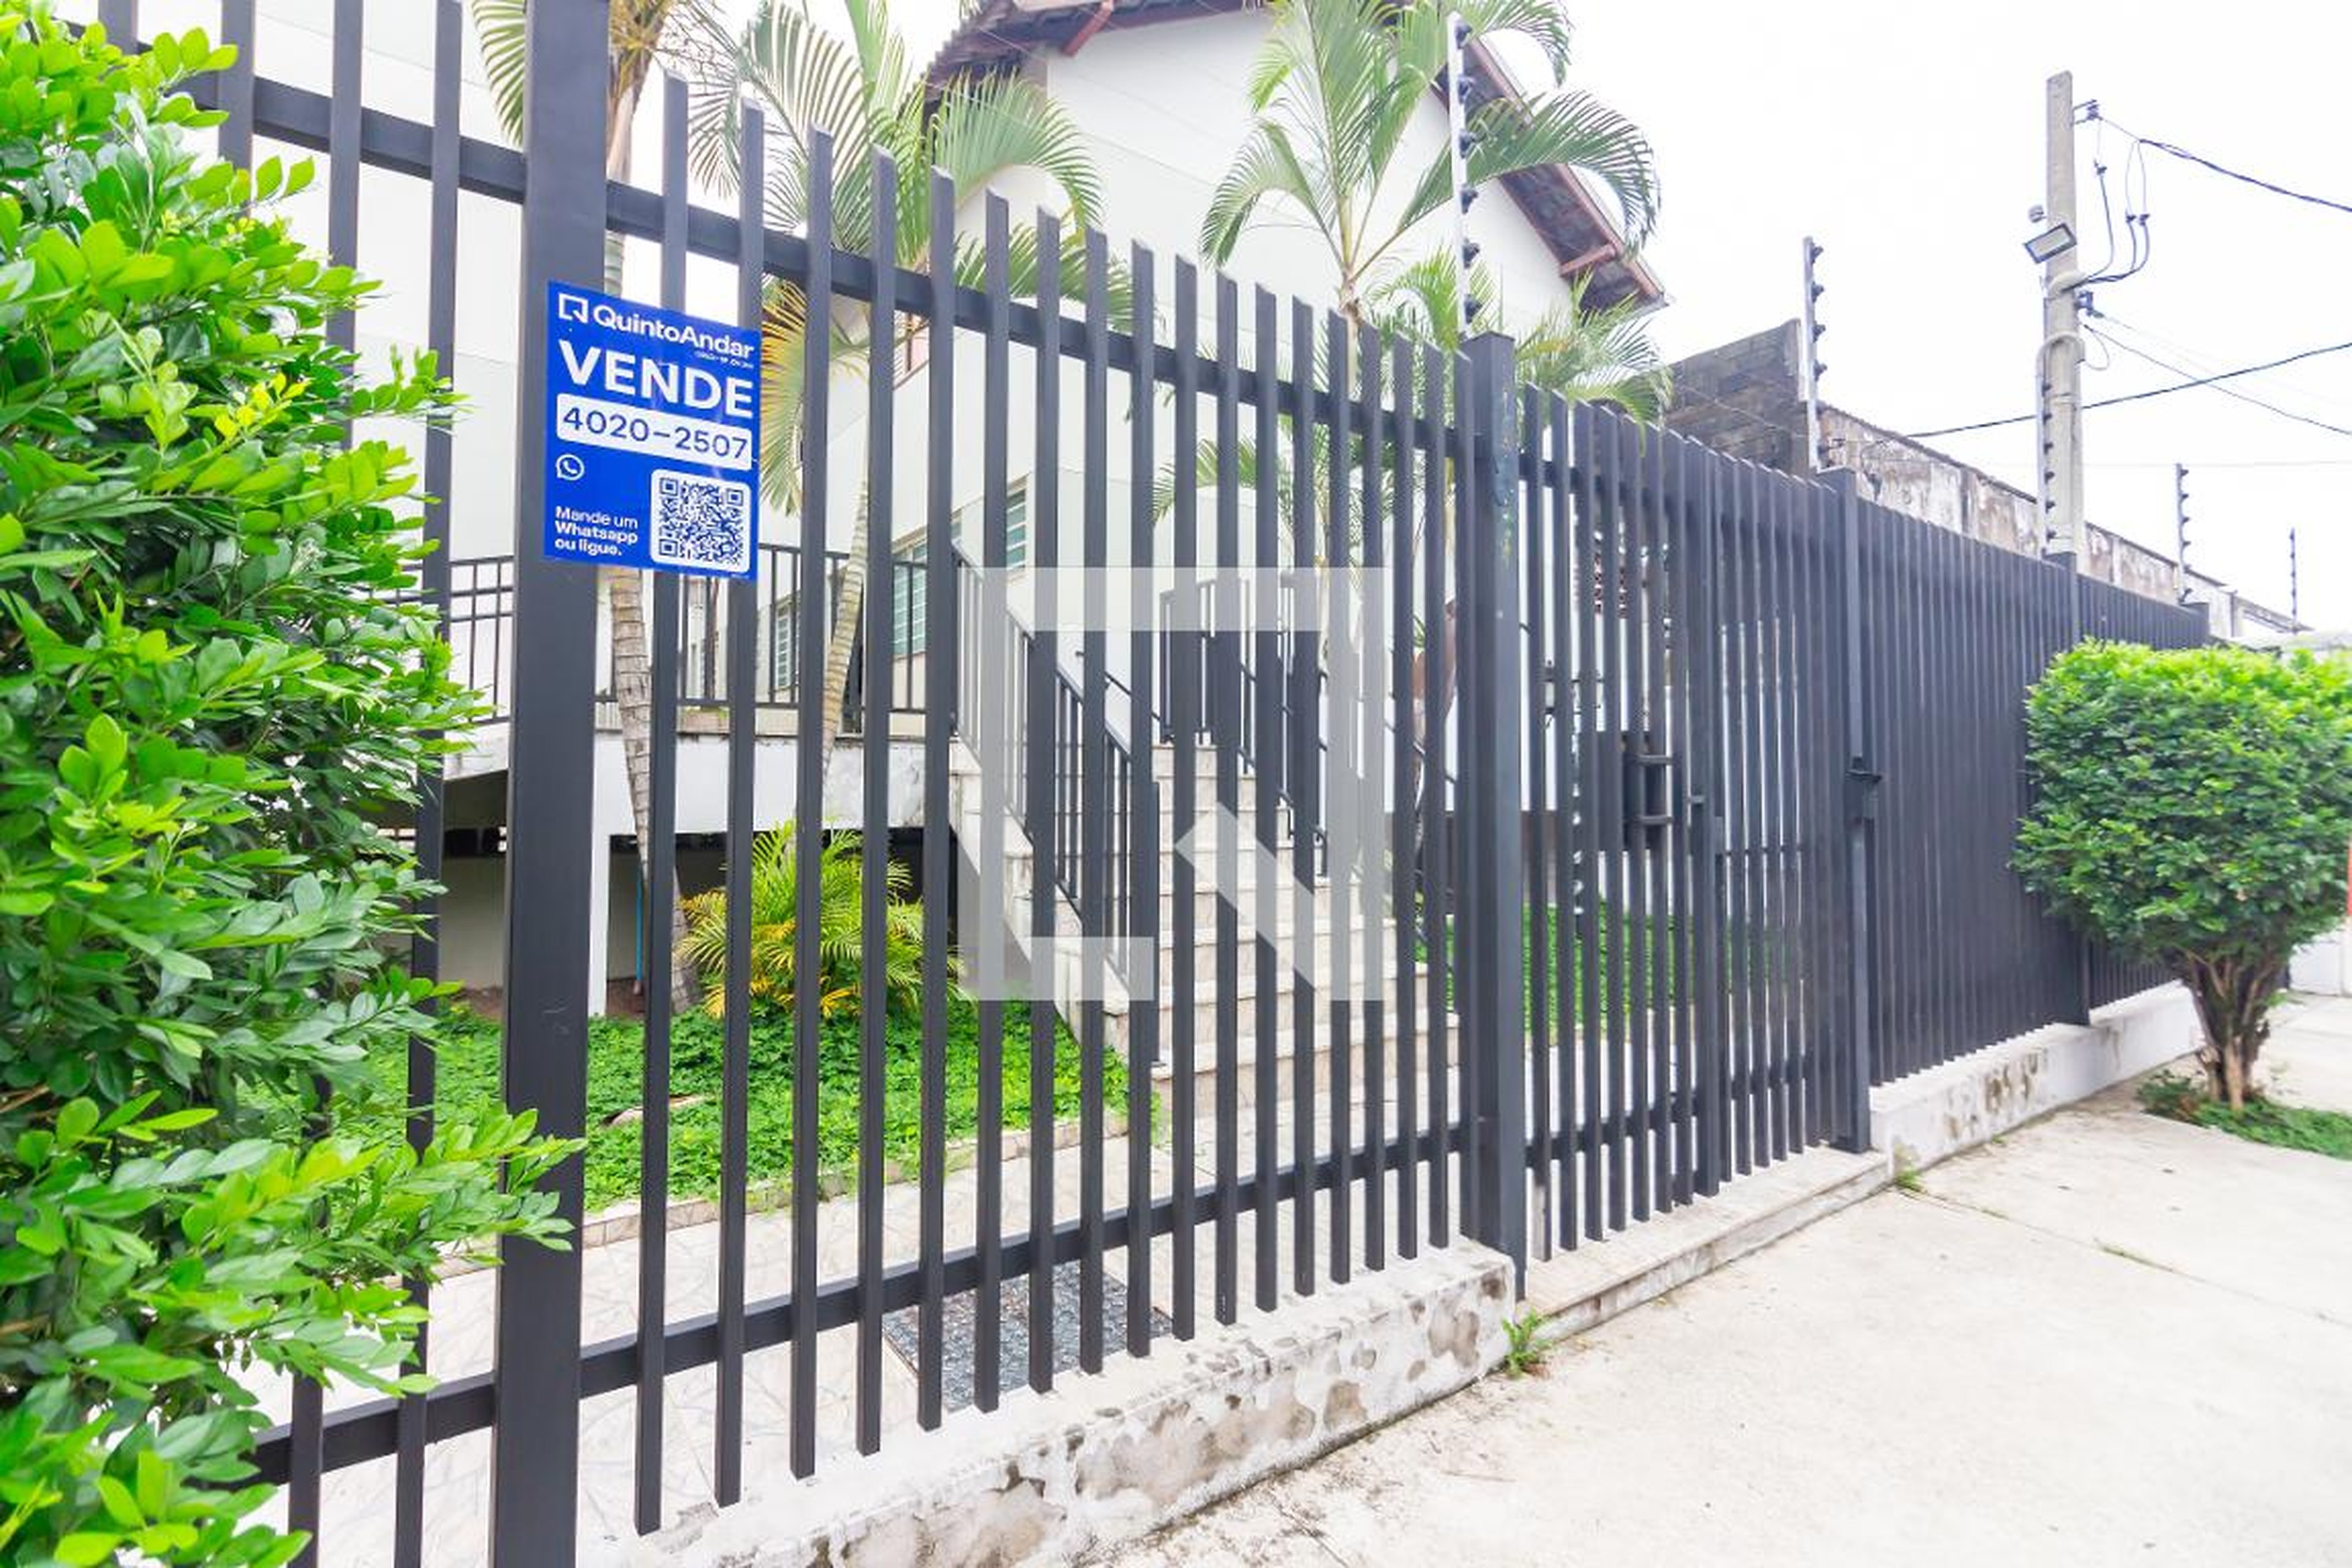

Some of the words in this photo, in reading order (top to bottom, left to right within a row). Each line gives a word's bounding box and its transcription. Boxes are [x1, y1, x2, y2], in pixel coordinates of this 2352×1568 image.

[593, 305, 754, 358] QuintoAndar
[559, 339, 753, 418] VENDE
[563, 407, 748, 459] 4020-2507
[555, 520, 638, 545] Whatsapp
[556, 505, 611, 526] Mande
[614, 516, 638, 529] um
[555, 538, 576, 551] ou
[579, 538, 622, 556] ligue.
